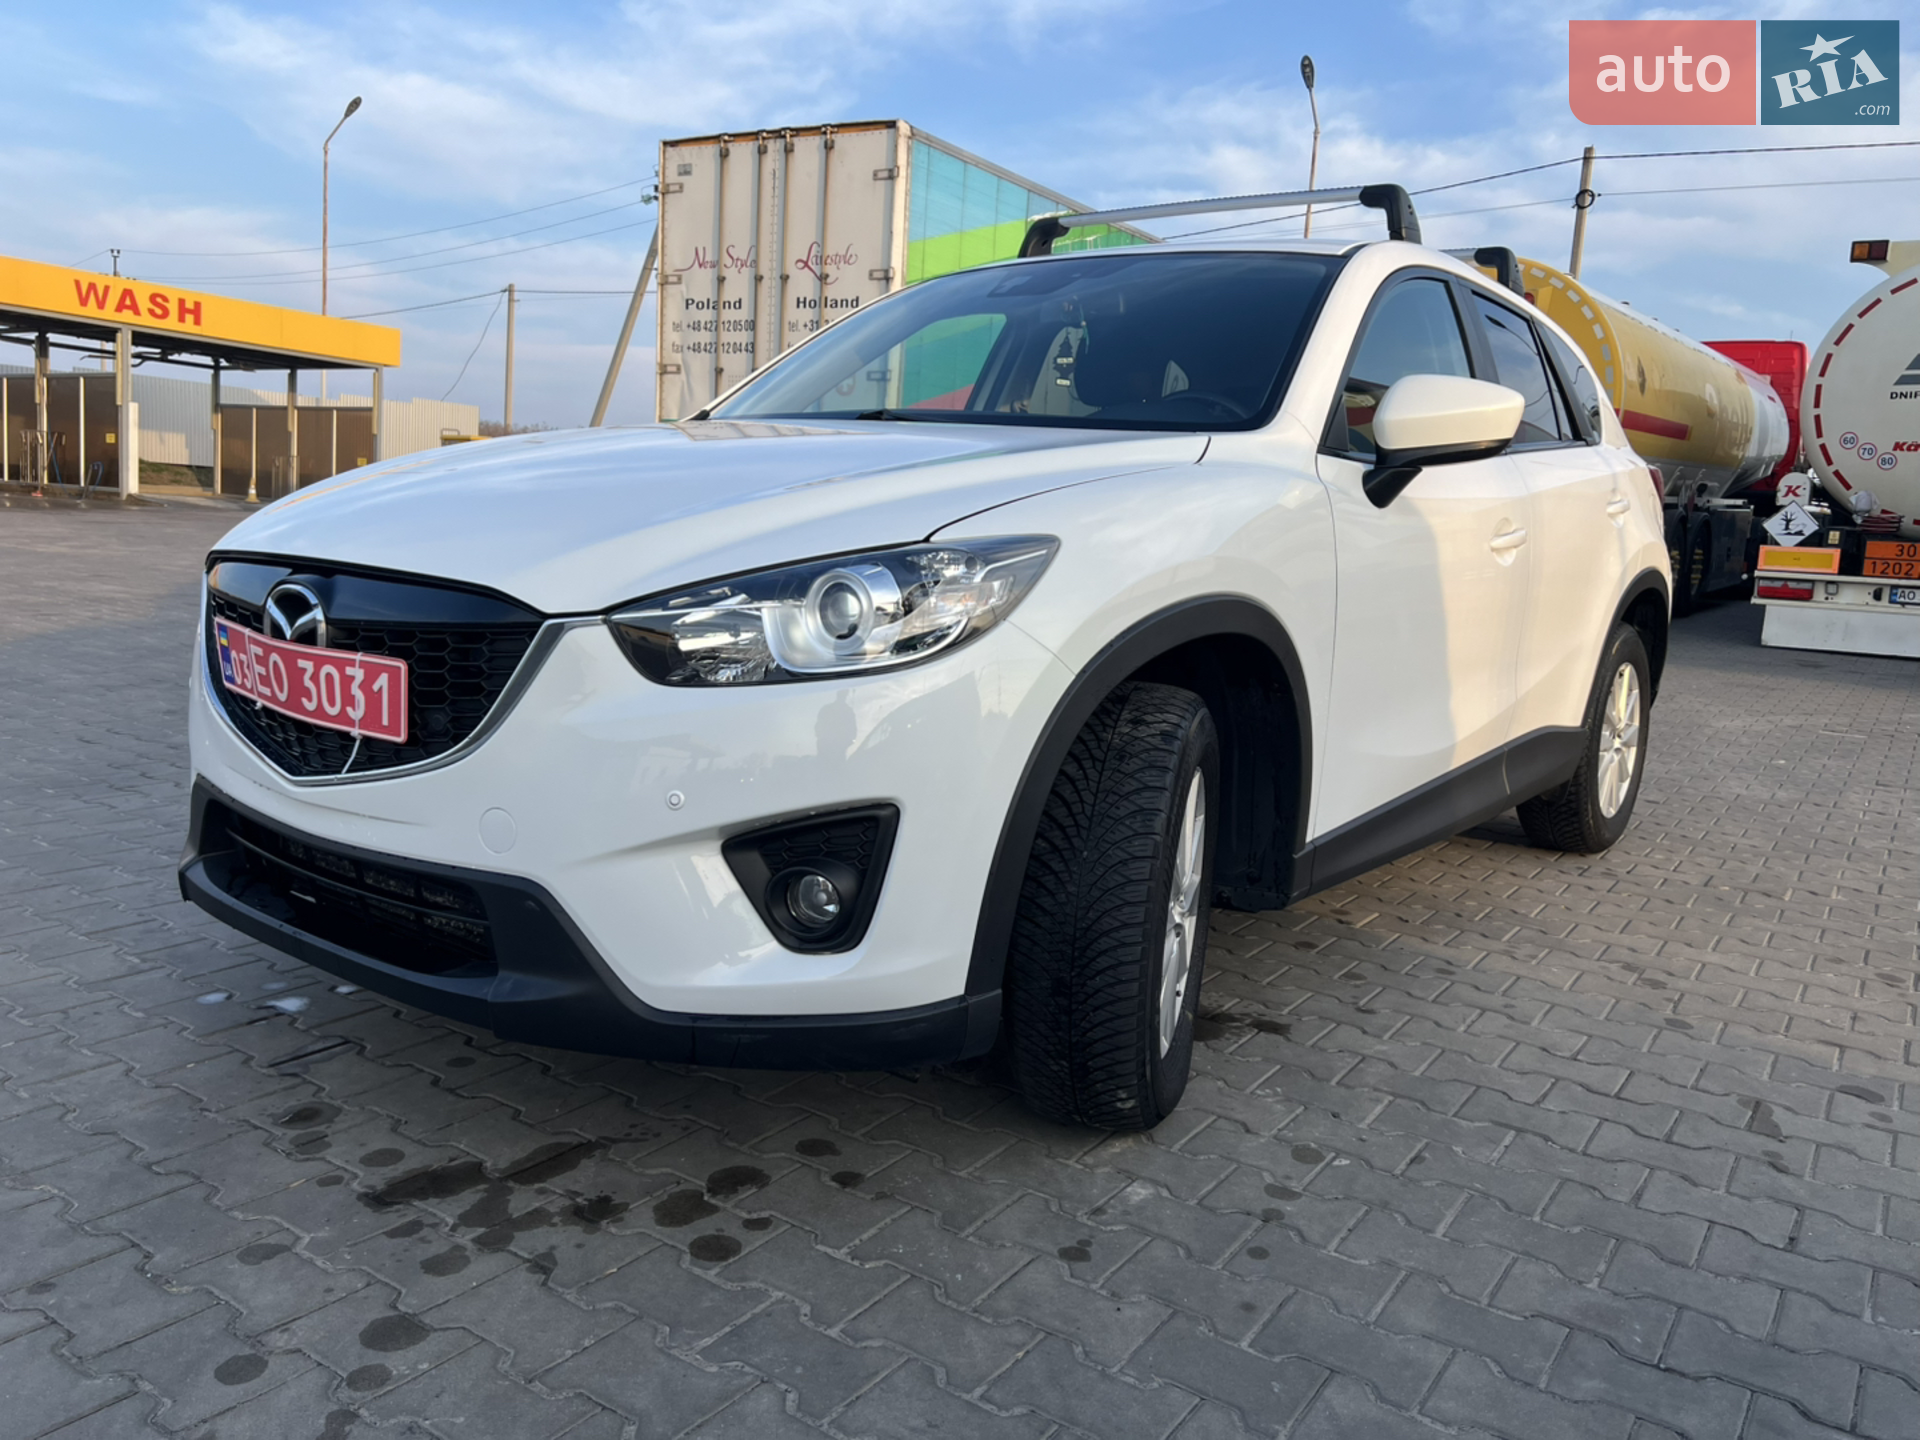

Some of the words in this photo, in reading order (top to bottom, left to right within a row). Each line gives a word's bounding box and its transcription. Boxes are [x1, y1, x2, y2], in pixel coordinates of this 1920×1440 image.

[673, 246, 719, 273] New
[724, 244, 757, 274] Style
[74, 279, 202, 327] WASH
[685, 297, 742, 311] Poland
[1842, 436, 1855, 446] 60
[1860, 447, 1874, 456] 70
[1880, 457, 1894, 466] 80
[1895, 543, 1917, 558] 30
[1871, 560, 1915, 577] 1202
[297, 658, 389, 726] 3031
